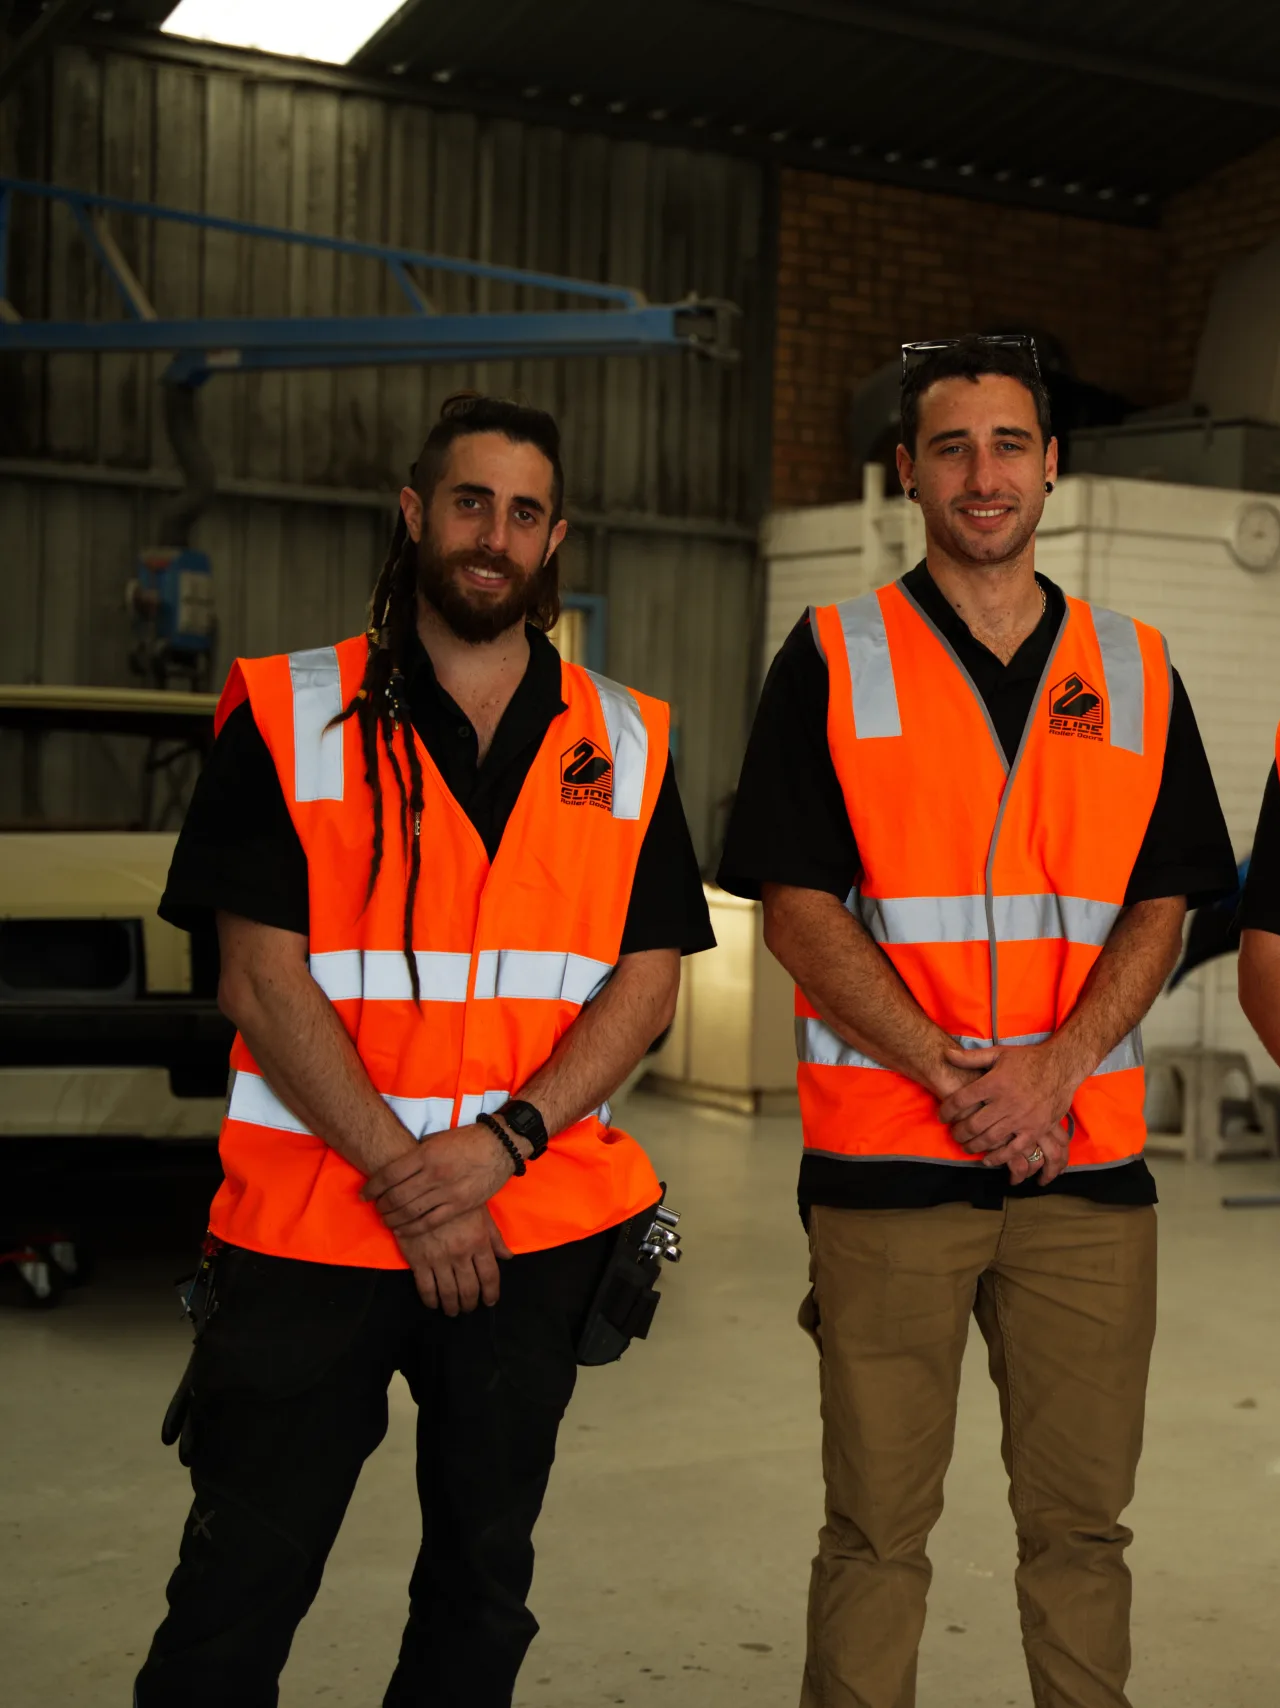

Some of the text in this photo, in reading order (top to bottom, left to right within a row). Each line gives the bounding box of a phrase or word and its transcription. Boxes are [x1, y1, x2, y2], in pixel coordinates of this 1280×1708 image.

[1049, 729, 1103, 742] Roller Doors
[561, 797, 612, 812] Roller Doors
